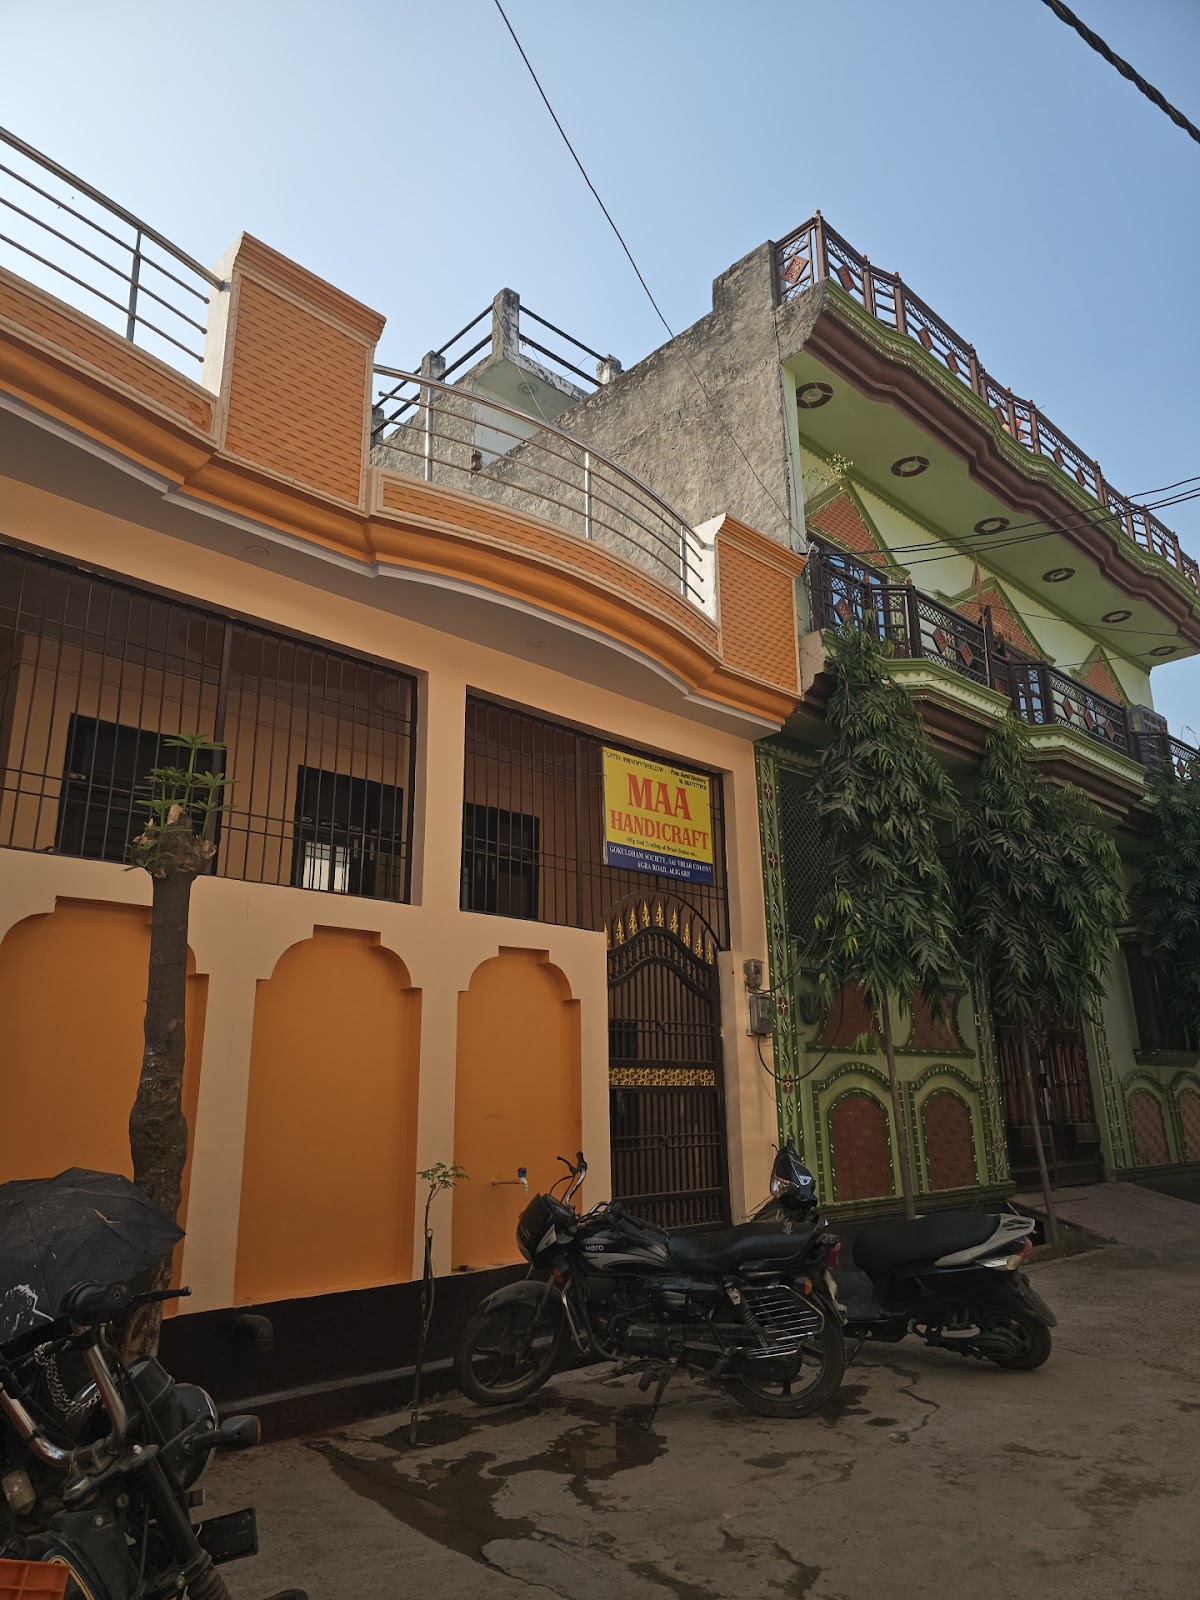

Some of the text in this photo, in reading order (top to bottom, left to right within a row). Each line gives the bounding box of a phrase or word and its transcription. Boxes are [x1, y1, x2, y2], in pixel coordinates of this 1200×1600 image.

[627, 773, 692, 821] MAA
[610, 809, 709, 850] HANDICRAFT
[609, 845, 644, 860] GOKULDHAM
[693, 863, 712, 873] COLONY
[637, 861, 652, 871] AGRA
[669, 868, 691, 878] ALIGARH
